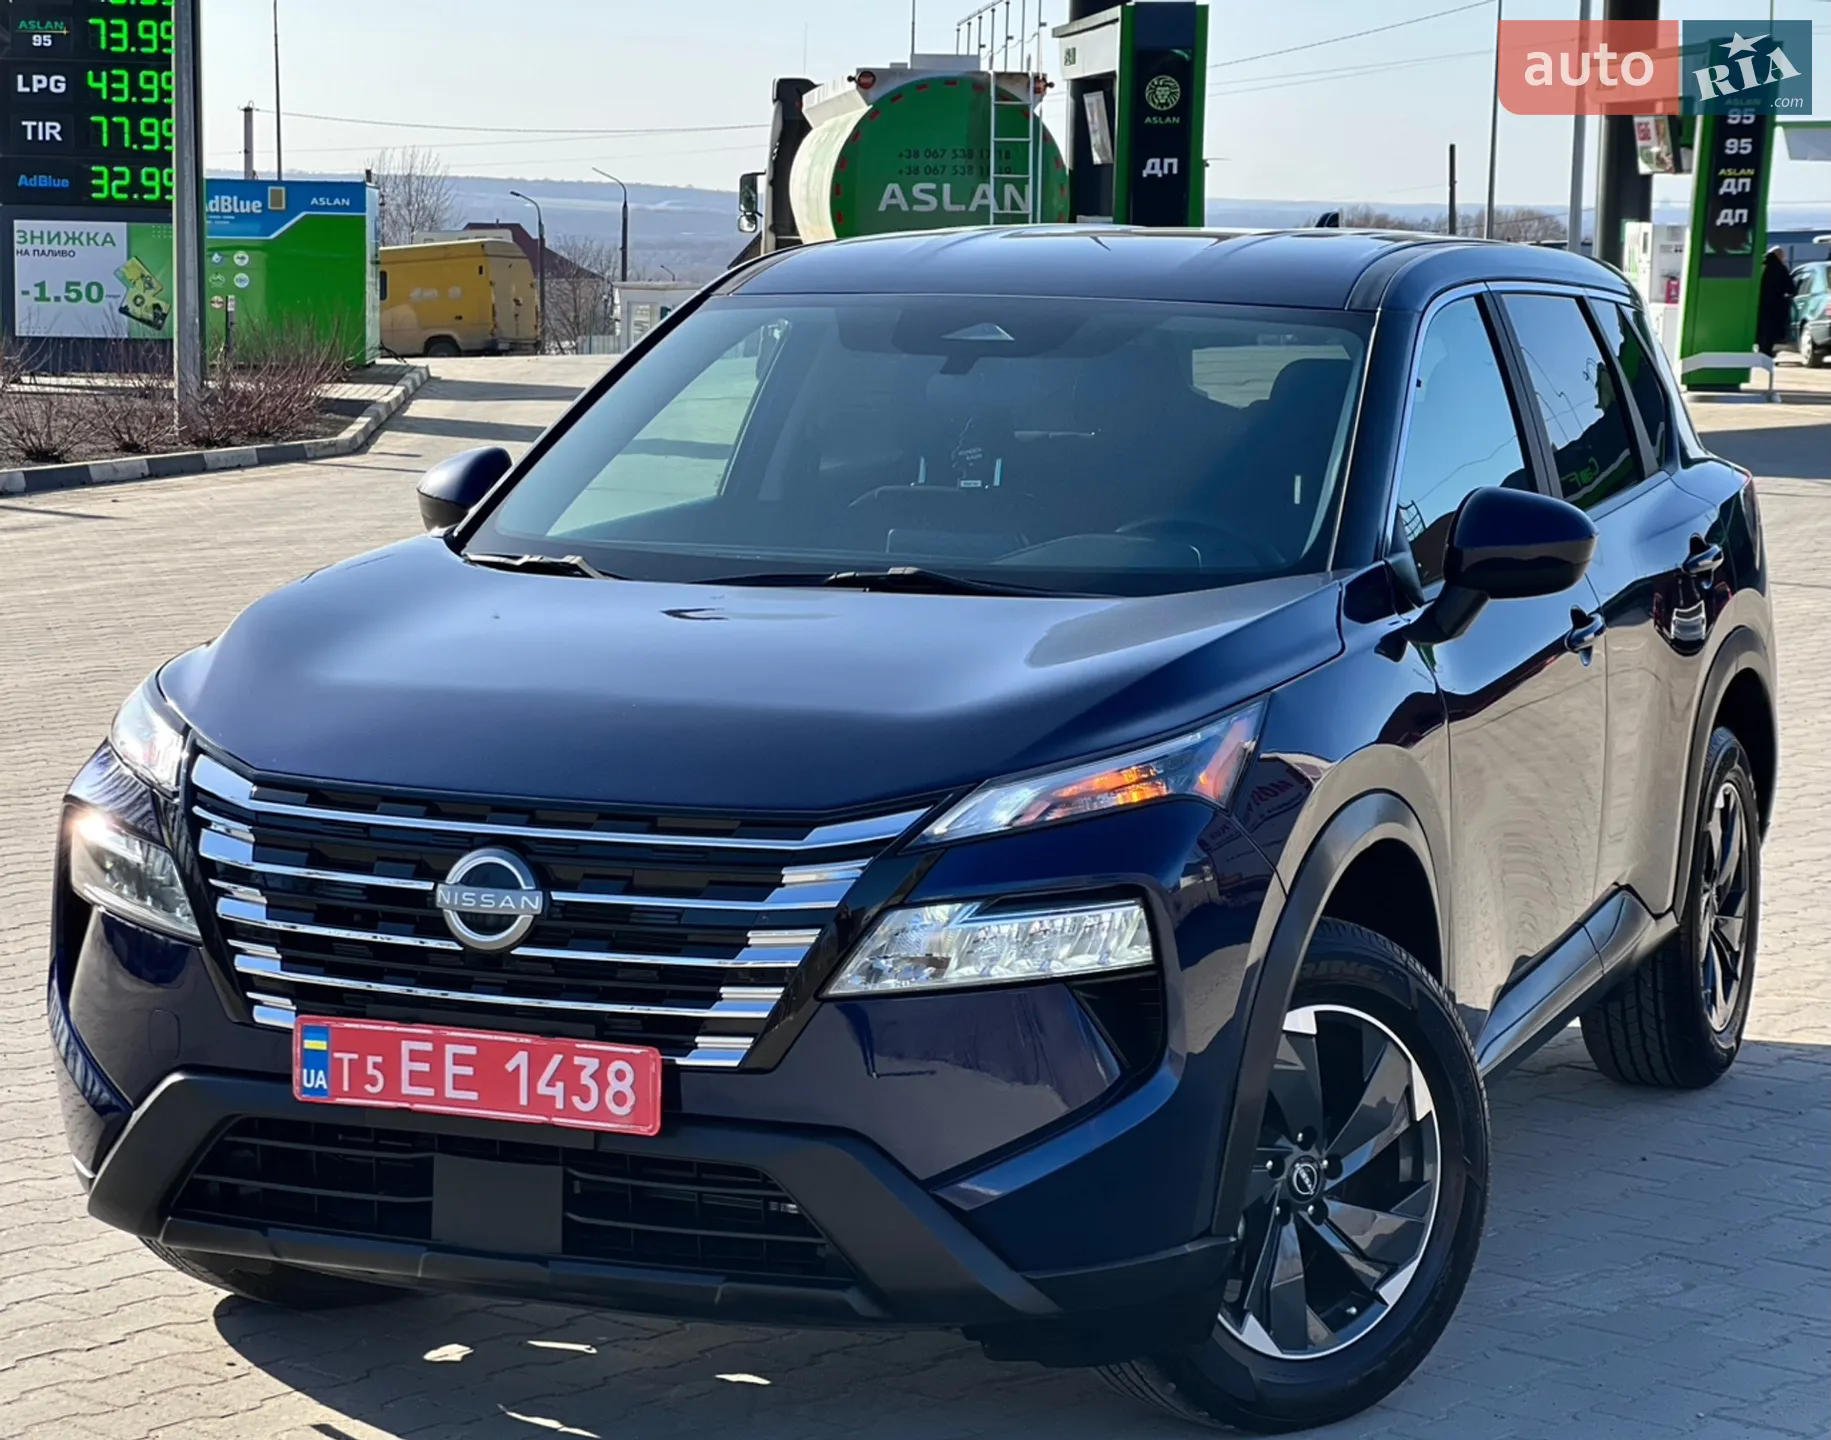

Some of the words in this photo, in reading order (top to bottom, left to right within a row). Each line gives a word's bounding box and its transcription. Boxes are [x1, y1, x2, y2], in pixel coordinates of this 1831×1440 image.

[18, 20, 65, 30] ASLAN
[32, 35, 53, 47] 95
[17, 74, 67, 94] LPG
[1144, 116, 1181, 124] ASLAN
[1727, 108, 1756, 125] 95
[21, 121, 63, 141] TIR
[924, 149, 946, 160] 067
[951, 148, 974, 160] 538
[1724, 138, 1753, 155] 95
[924, 165, 946, 176] 067
[951, 165, 974, 176] 538
[1142, 158, 1179, 178] ДП
[1718, 168, 1756, 176] ASLAN
[17, 174, 70, 188] AdBlue
[1718, 178, 1752, 196] ДП
[310, 197, 350, 206] ASLAN
[878, 183, 1030, 212] ASLAN
[1715, 208, 1749, 227] ДП
[16, 229, 116, 247] ЗНИЖКА
[16, 249, 30, 257] НА
[33, 249, 76, 258] ПАЛИВО
[21, 280, 104, 304] -1.50
[438, 889, 540, 910] NISSAN
[302, 1068, 328, 1090] UA
[401, 1040, 479, 1101] EE
[505, 1050, 636, 1116] 1438
